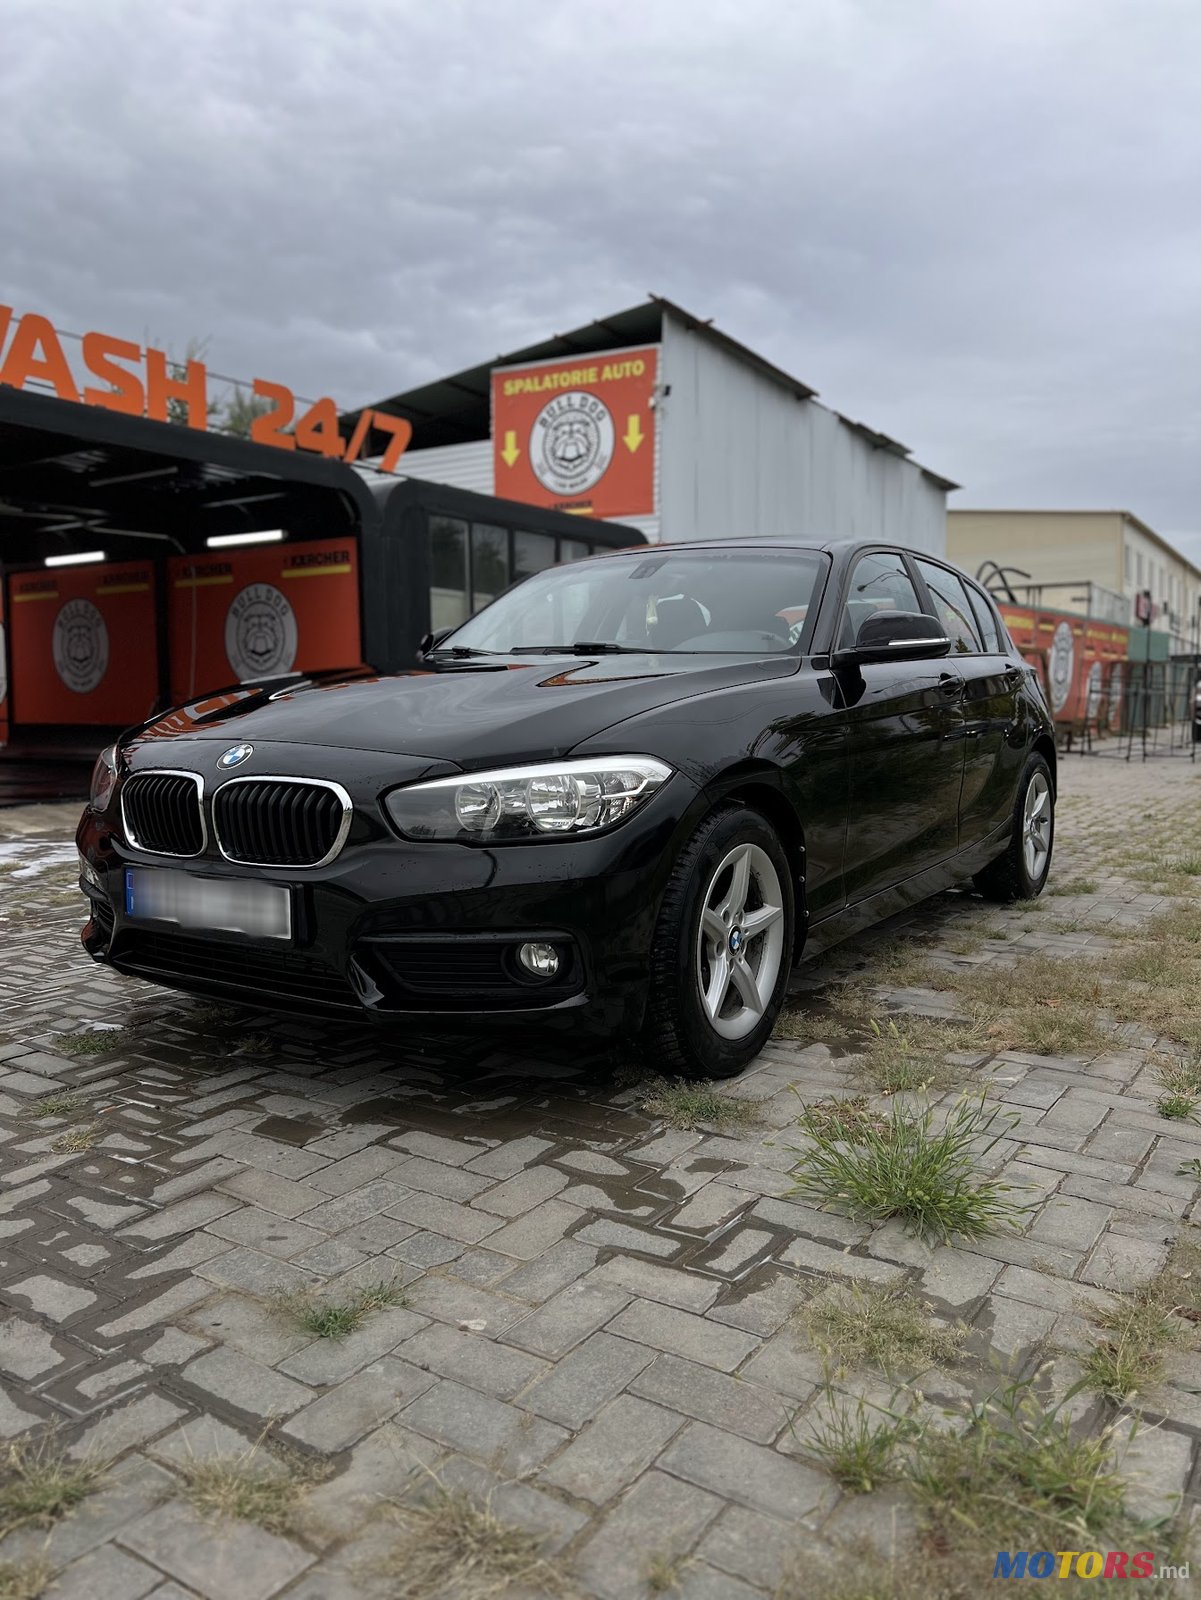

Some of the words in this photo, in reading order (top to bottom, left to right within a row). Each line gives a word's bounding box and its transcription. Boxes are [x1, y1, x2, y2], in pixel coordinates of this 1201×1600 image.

[504, 367, 598, 396] SPALATORIE
[602, 359, 644, 381] AUTO
[251, 378, 412, 473] 24/7
